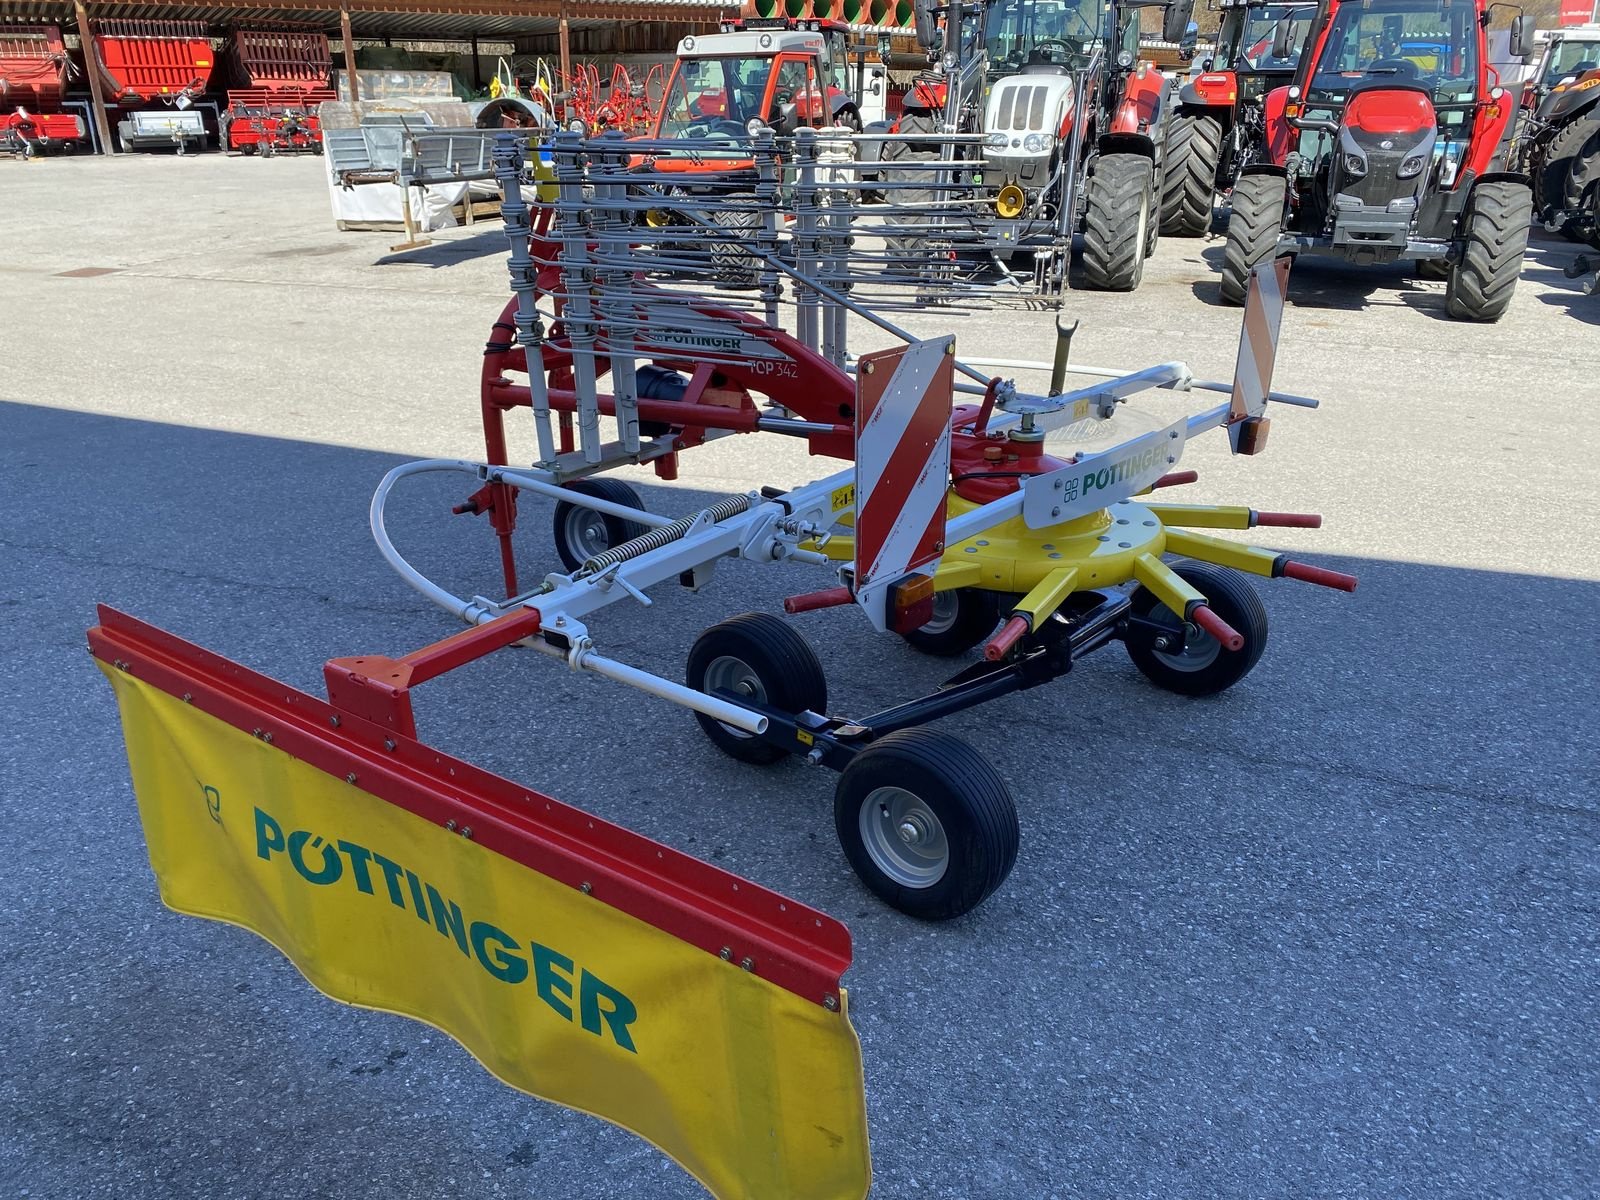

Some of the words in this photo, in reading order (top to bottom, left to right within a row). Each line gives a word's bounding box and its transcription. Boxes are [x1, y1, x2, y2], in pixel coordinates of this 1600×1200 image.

[748, 360, 774, 375] TOP
[776, 362, 799, 378] 342
[1082, 443, 1169, 496] PÖTTINGER
[255, 806, 637, 1053] PÖTTINGER
